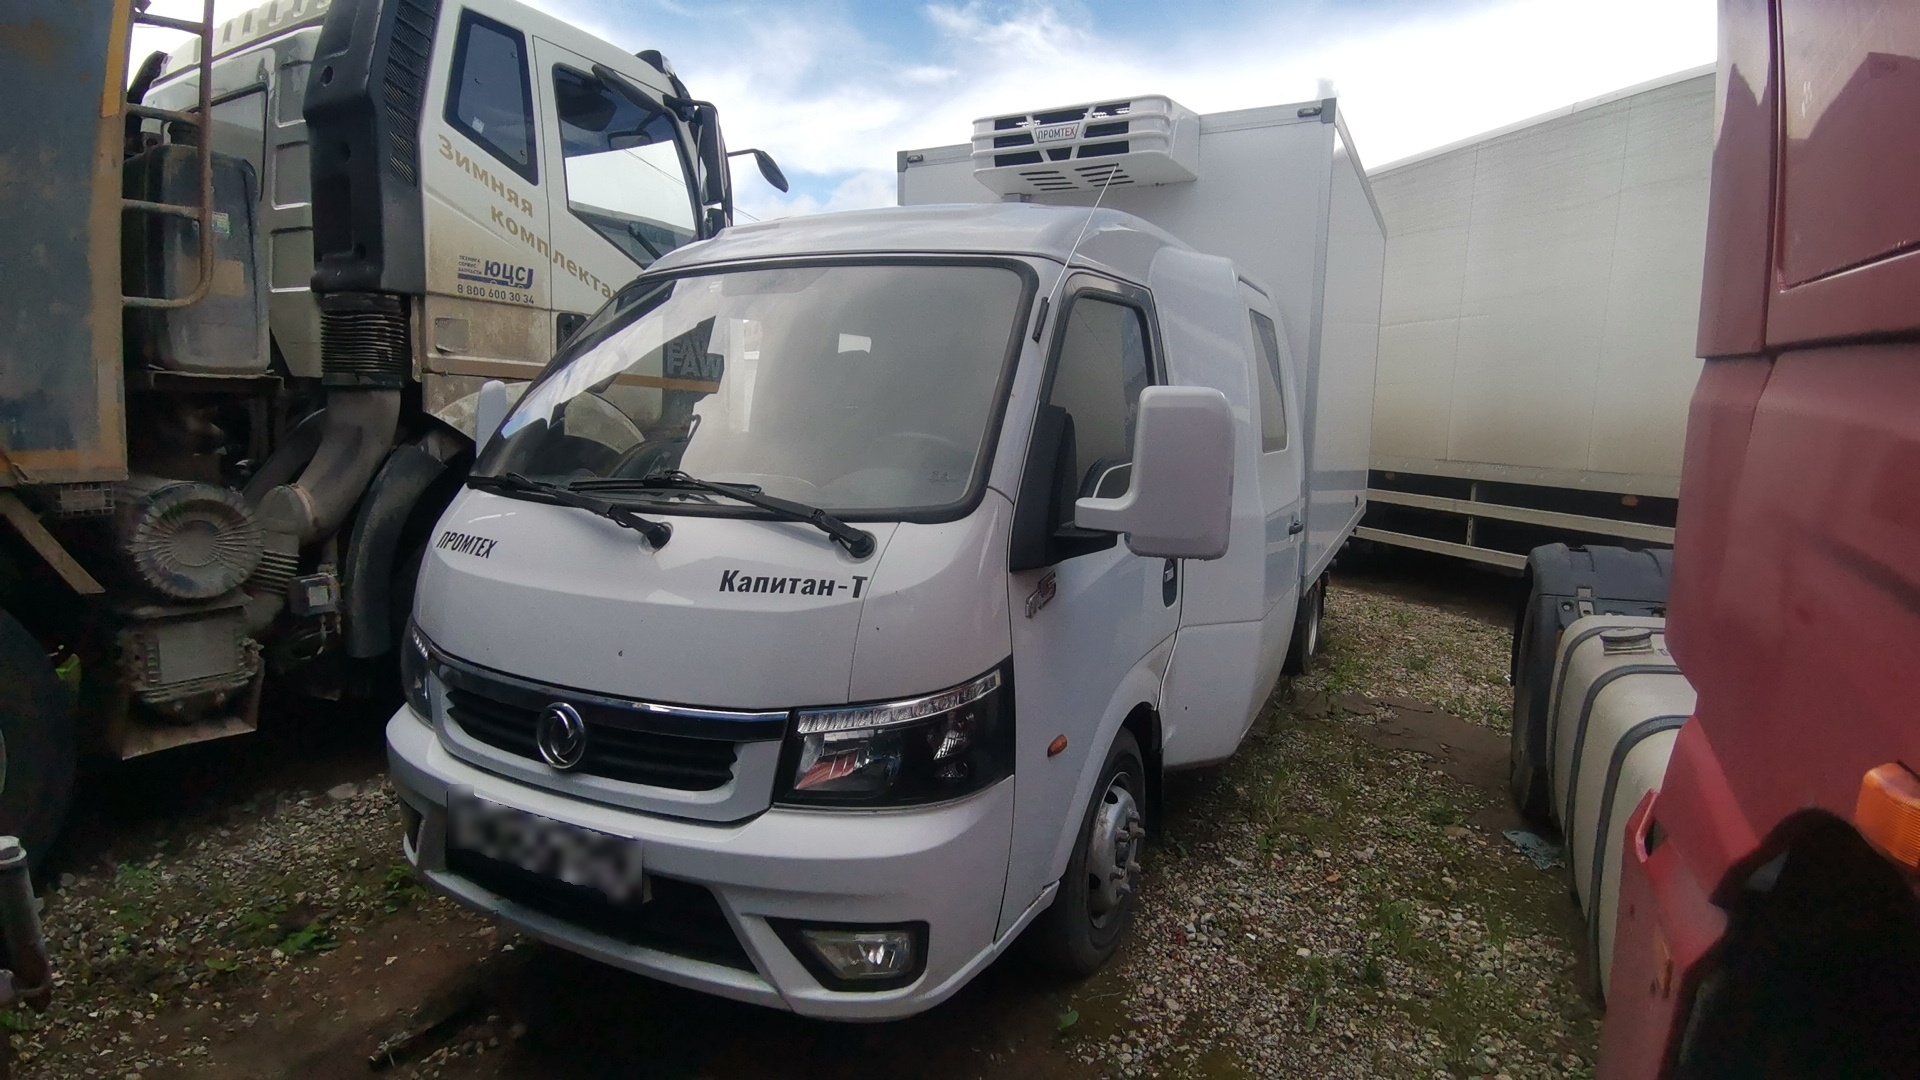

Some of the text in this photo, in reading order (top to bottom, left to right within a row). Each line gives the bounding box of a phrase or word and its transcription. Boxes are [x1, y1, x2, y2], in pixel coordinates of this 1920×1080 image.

[1038, 126, 1075, 139] ПРОМТЕХ
[438, 133, 533, 218] Зимняя
[457, 283, 535, 305] 8 800 600 30 34
[436, 530, 498, 559] ПРОМТЕХ
[719, 569, 868, 599] Капитан-Т
